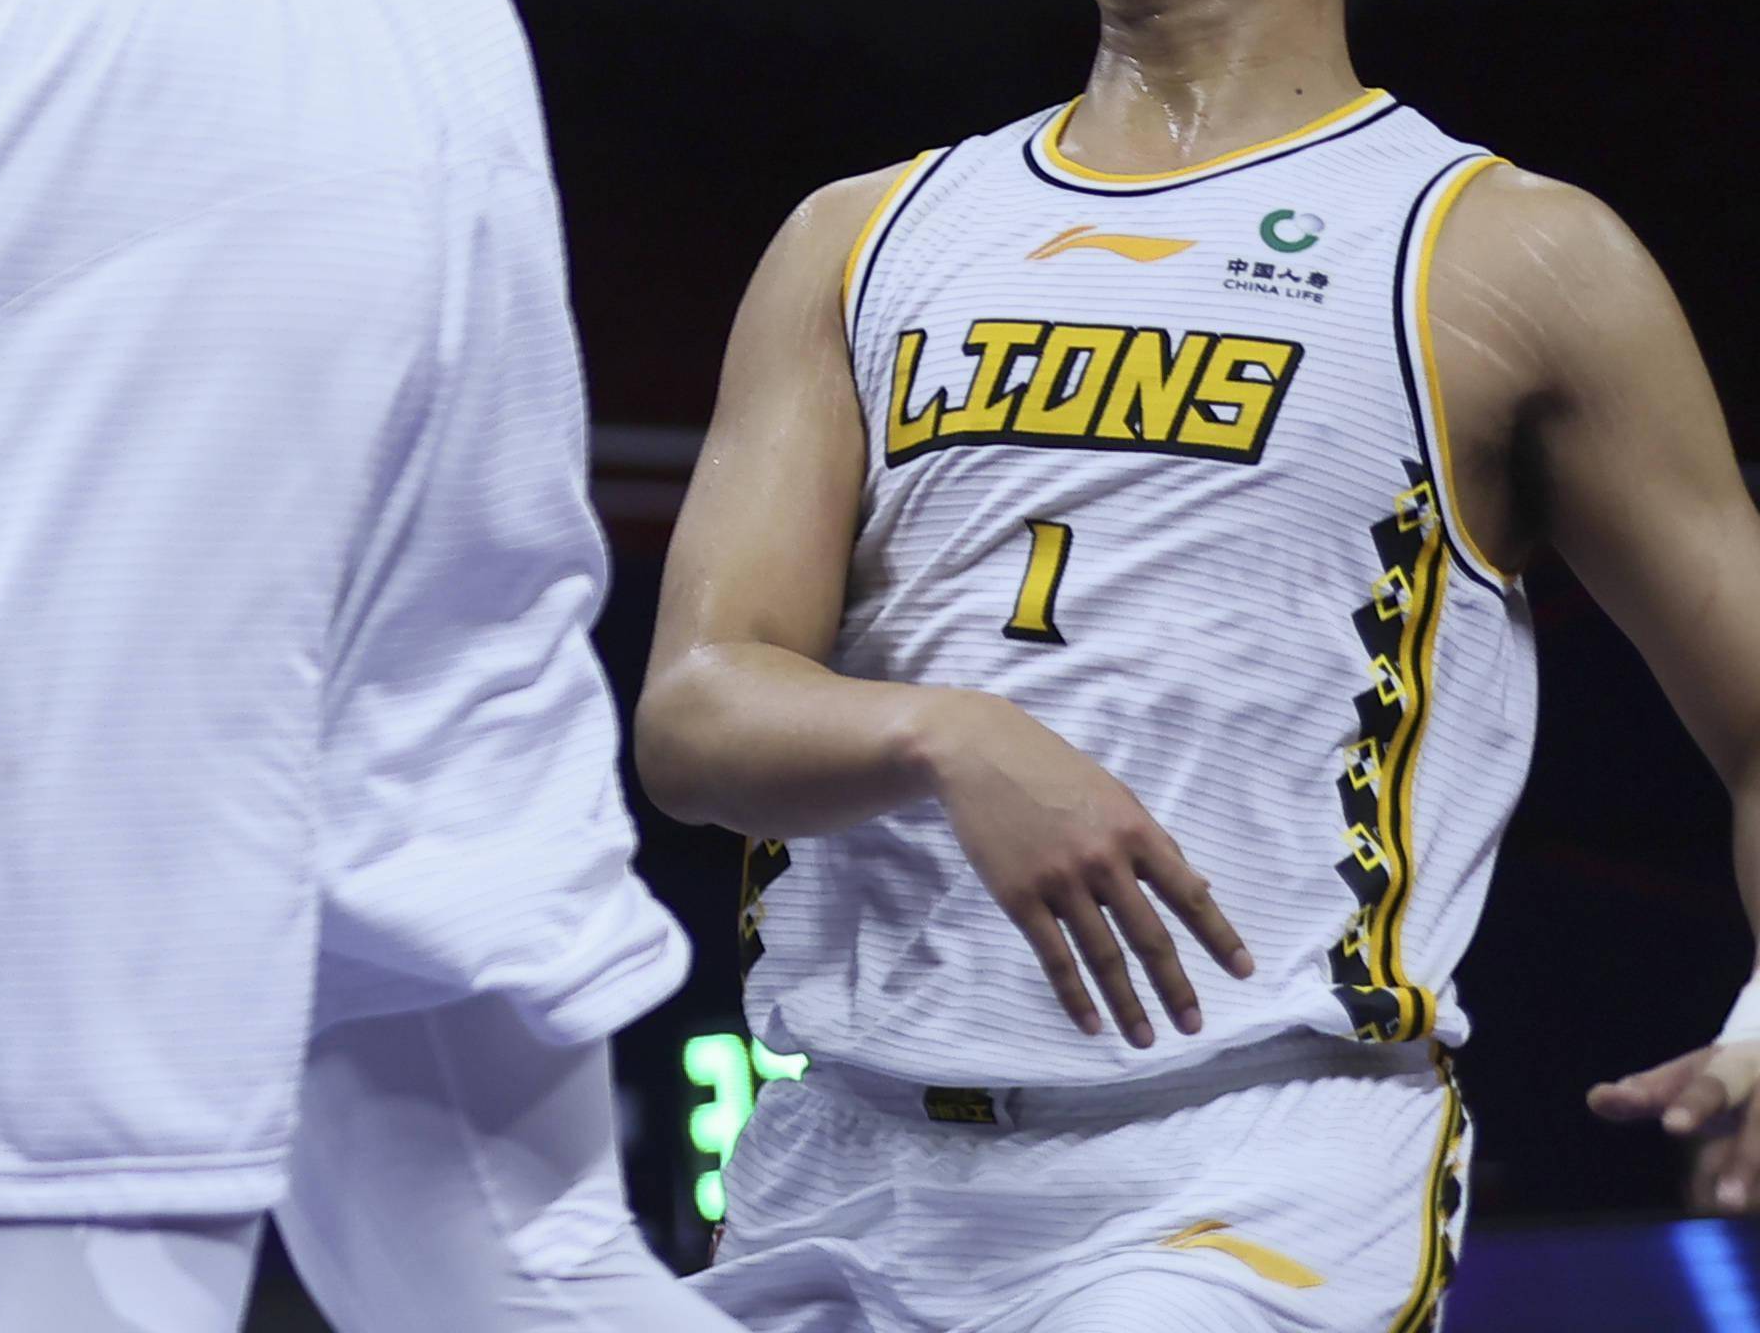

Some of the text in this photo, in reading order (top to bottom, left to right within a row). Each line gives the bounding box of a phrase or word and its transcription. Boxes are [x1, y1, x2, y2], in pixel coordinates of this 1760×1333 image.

[1223, 278, 1325, 304] CHINA LIFE
[885, 318, 1304, 468] LIONS
[1002, 518, 1072, 646] 1
